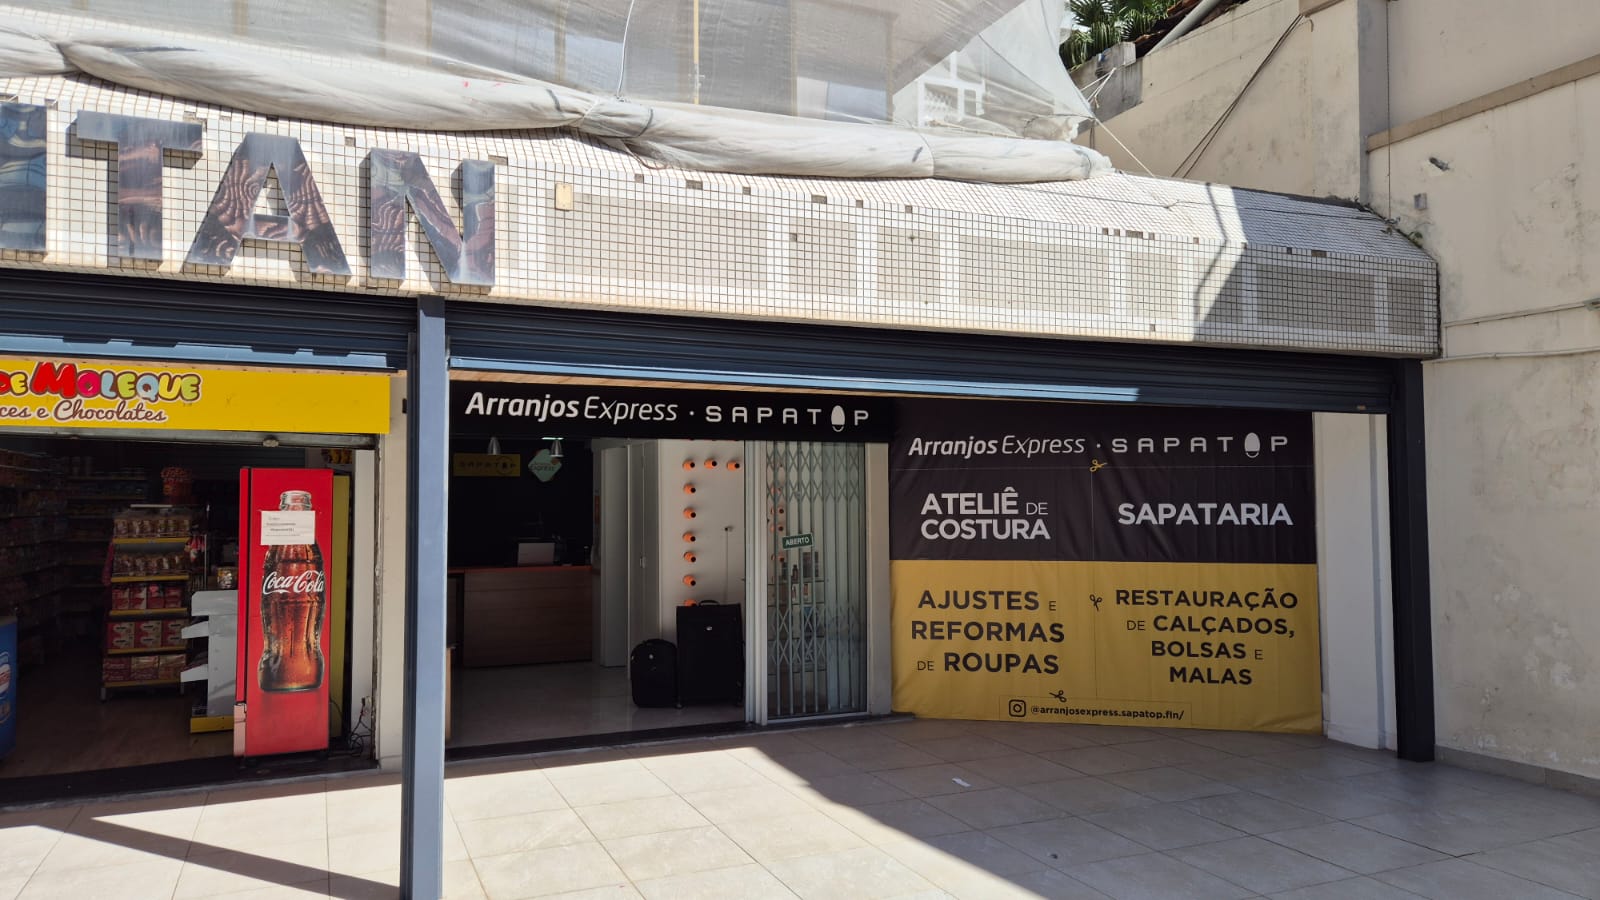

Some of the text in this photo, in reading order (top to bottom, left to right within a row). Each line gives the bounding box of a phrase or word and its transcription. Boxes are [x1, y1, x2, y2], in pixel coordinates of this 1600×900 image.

[30, 361, 201, 403] MOLEQUE
[36, 407, 48, 418] e
[54, 400, 166, 421] Chocolates
[465, 392, 869, 432] Arranjos Express SAPATOP
[908, 432, 1288, 458] Arranjos Express SAPATOP
[921, 487, 1049, 515] ATELIÊ DE
[1118, 503, 1293, 526] SAPATARIA
[785, 536, 811, 546] ABERTO
[921, 519, 1050, 540] COSTURA
[918, 590, 1057, 611] AJUSTES E
[1116, 588, 1298, 612] RESTAURAÇÃO
[912, 620, 1065, 643] REFORMAS
[1127, 616, 1295, 639] DE CALÇADOS,
[1151, 641, 1264, 660] BOLSAS E
[917, 652, 1059, 675] DE ROUPAS
[1169, 667, 1253, 685] MALAS
